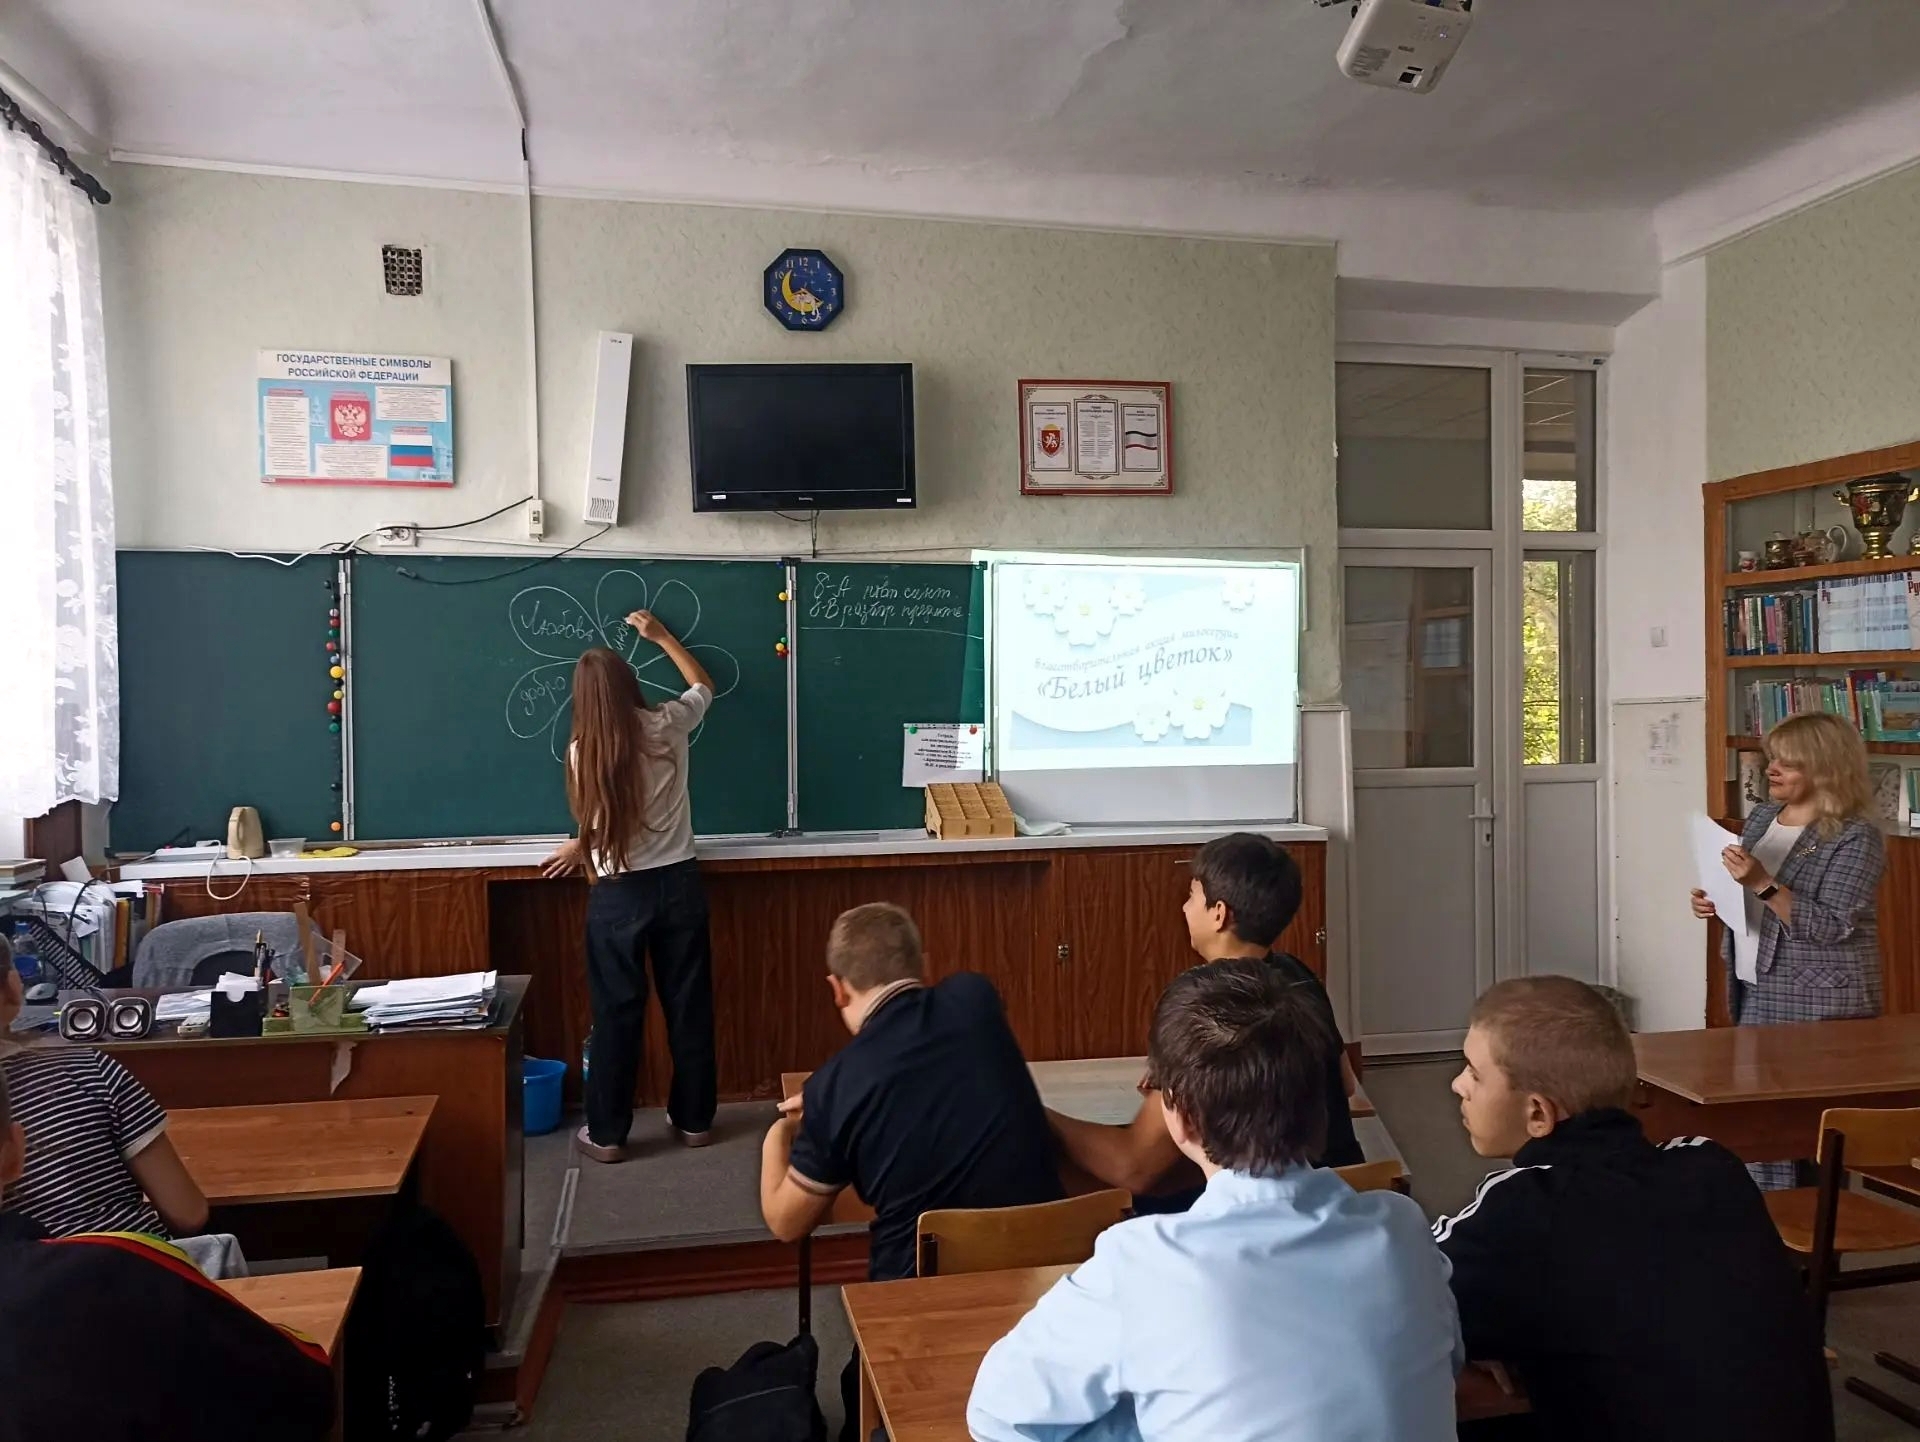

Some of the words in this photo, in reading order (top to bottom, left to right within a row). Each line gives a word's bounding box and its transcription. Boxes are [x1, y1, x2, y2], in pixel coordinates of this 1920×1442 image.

[786, 259, 794, 268] 11
[799, 257, 808, 267] 12
[276, 354, 377, 367] ГОСУДАРСТВЕННЫЕ
[379, 358, 432, 369] СИМВОЛЫ
[288, 367, 356, 379] РОССИЙСКОЙ
[358, 371, 419, 382] ФЕДЕРАЦИИ
[1037, 664, 1126, 700] «Белый
[1139, 645, 1234, 686] цветок»
[520, 672, 567, 716] добро
